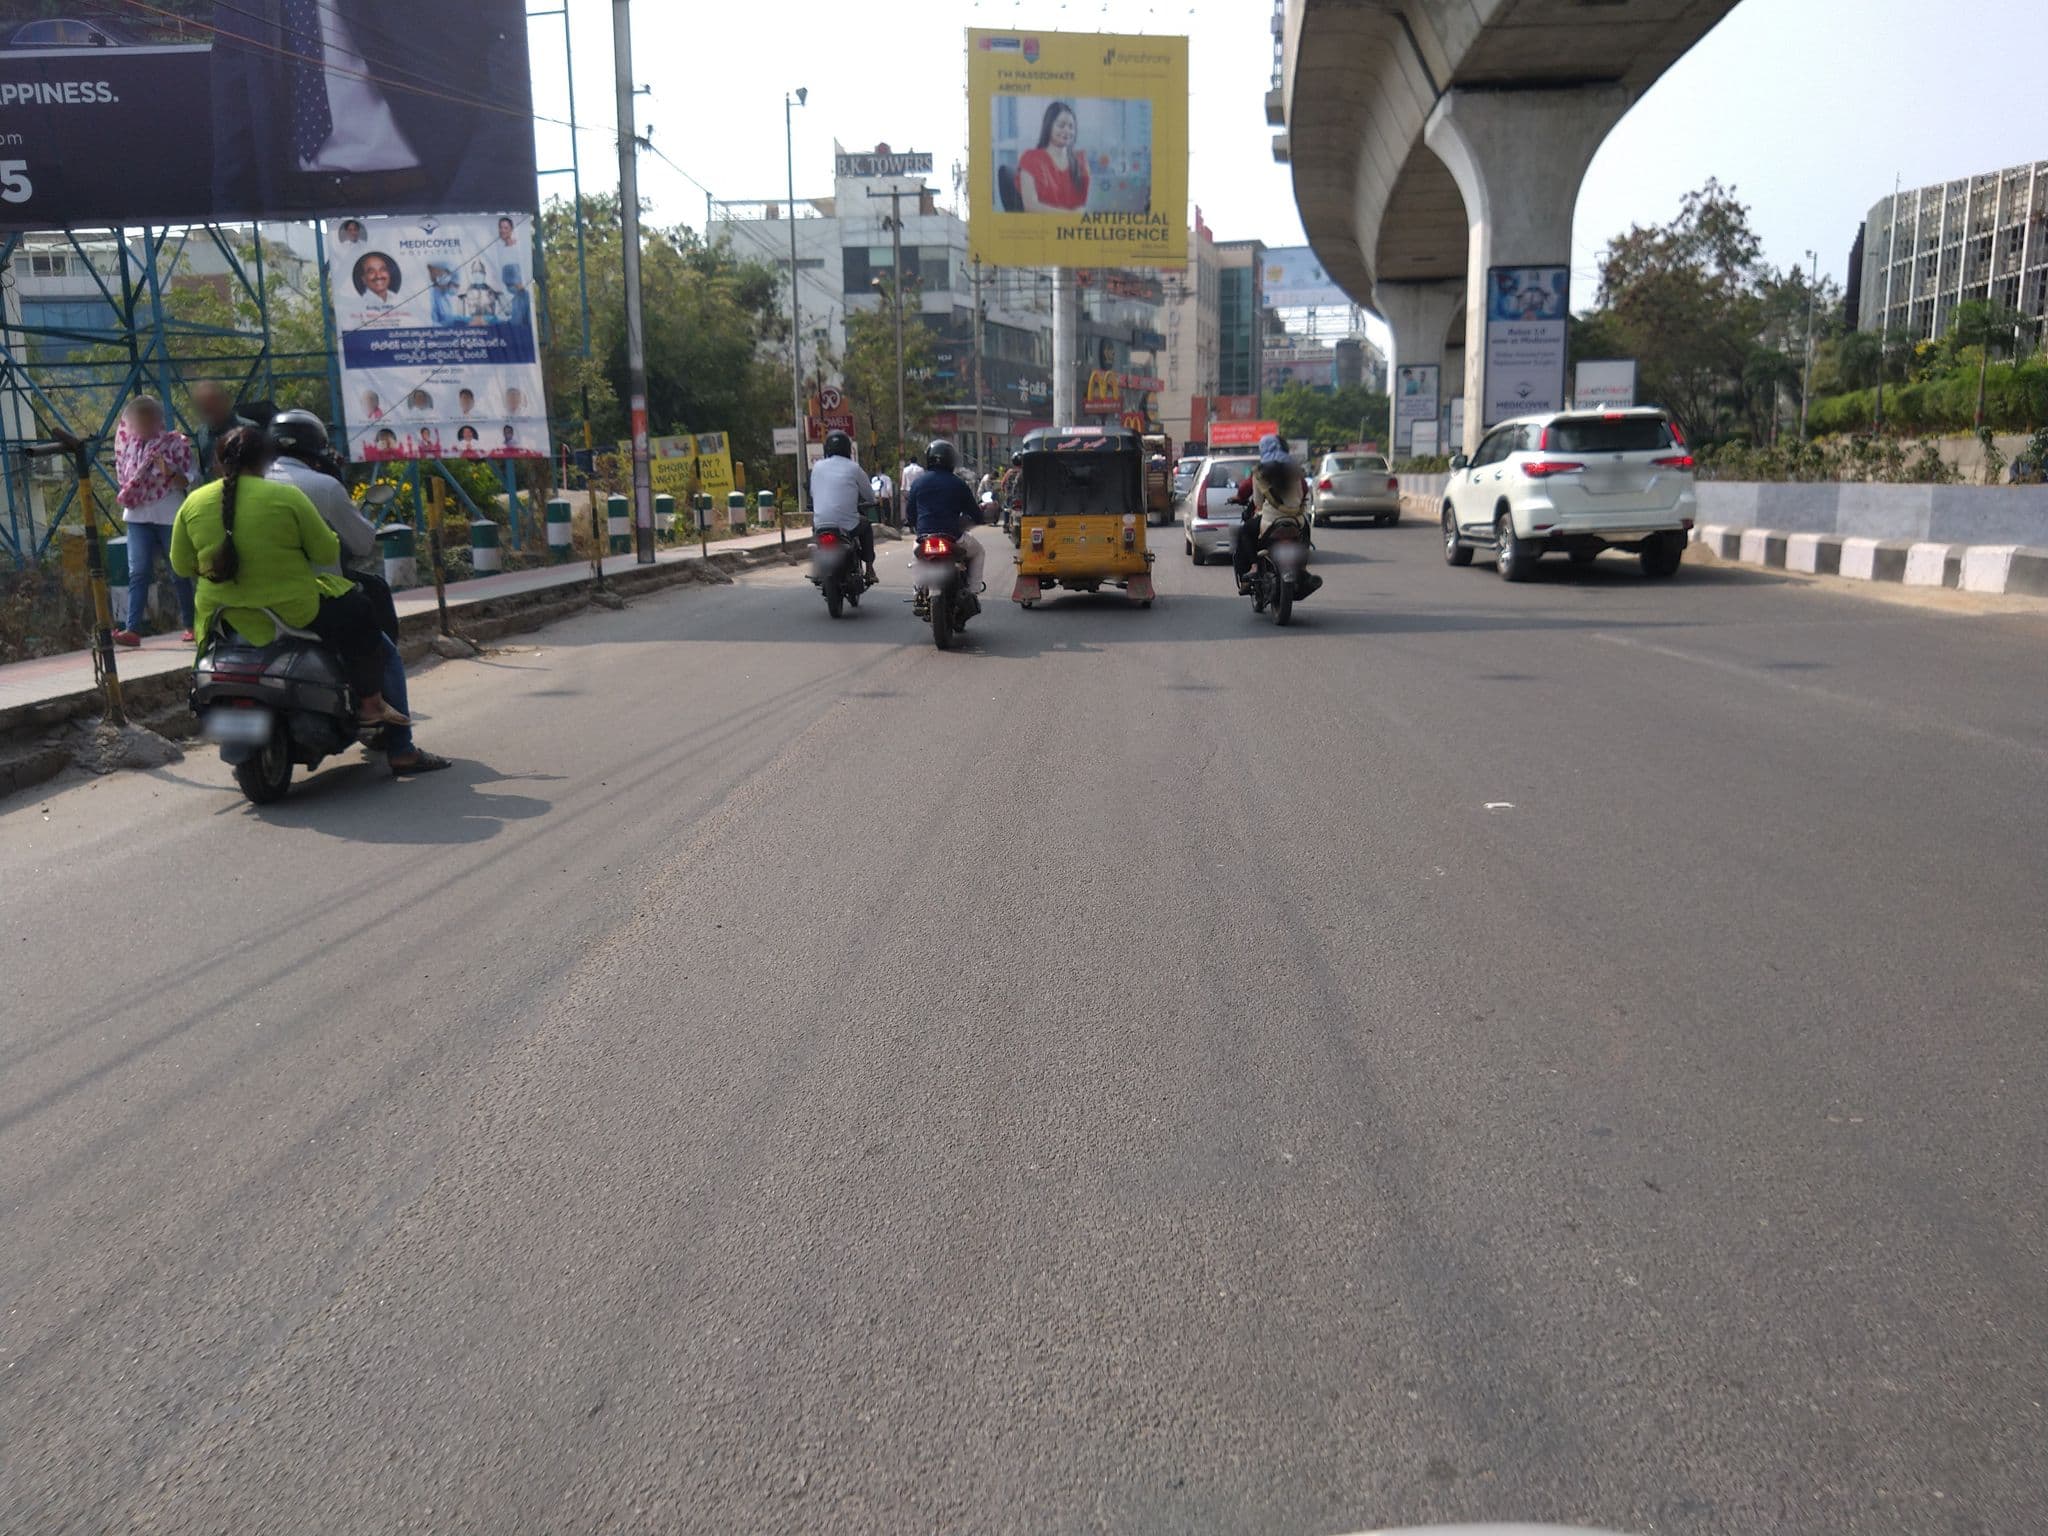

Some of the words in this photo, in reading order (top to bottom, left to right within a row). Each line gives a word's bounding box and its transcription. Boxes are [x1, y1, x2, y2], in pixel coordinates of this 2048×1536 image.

[0, 81, 119, 105] PPINESS.
[867, 156, 932, 174] TOWERS
[1080, 212, 1169, 226] ARTIFICIAL
[1056, 227, 1169, 242] INTELLIGENCE
[399, 238, 461, 249] MEDICOVER
